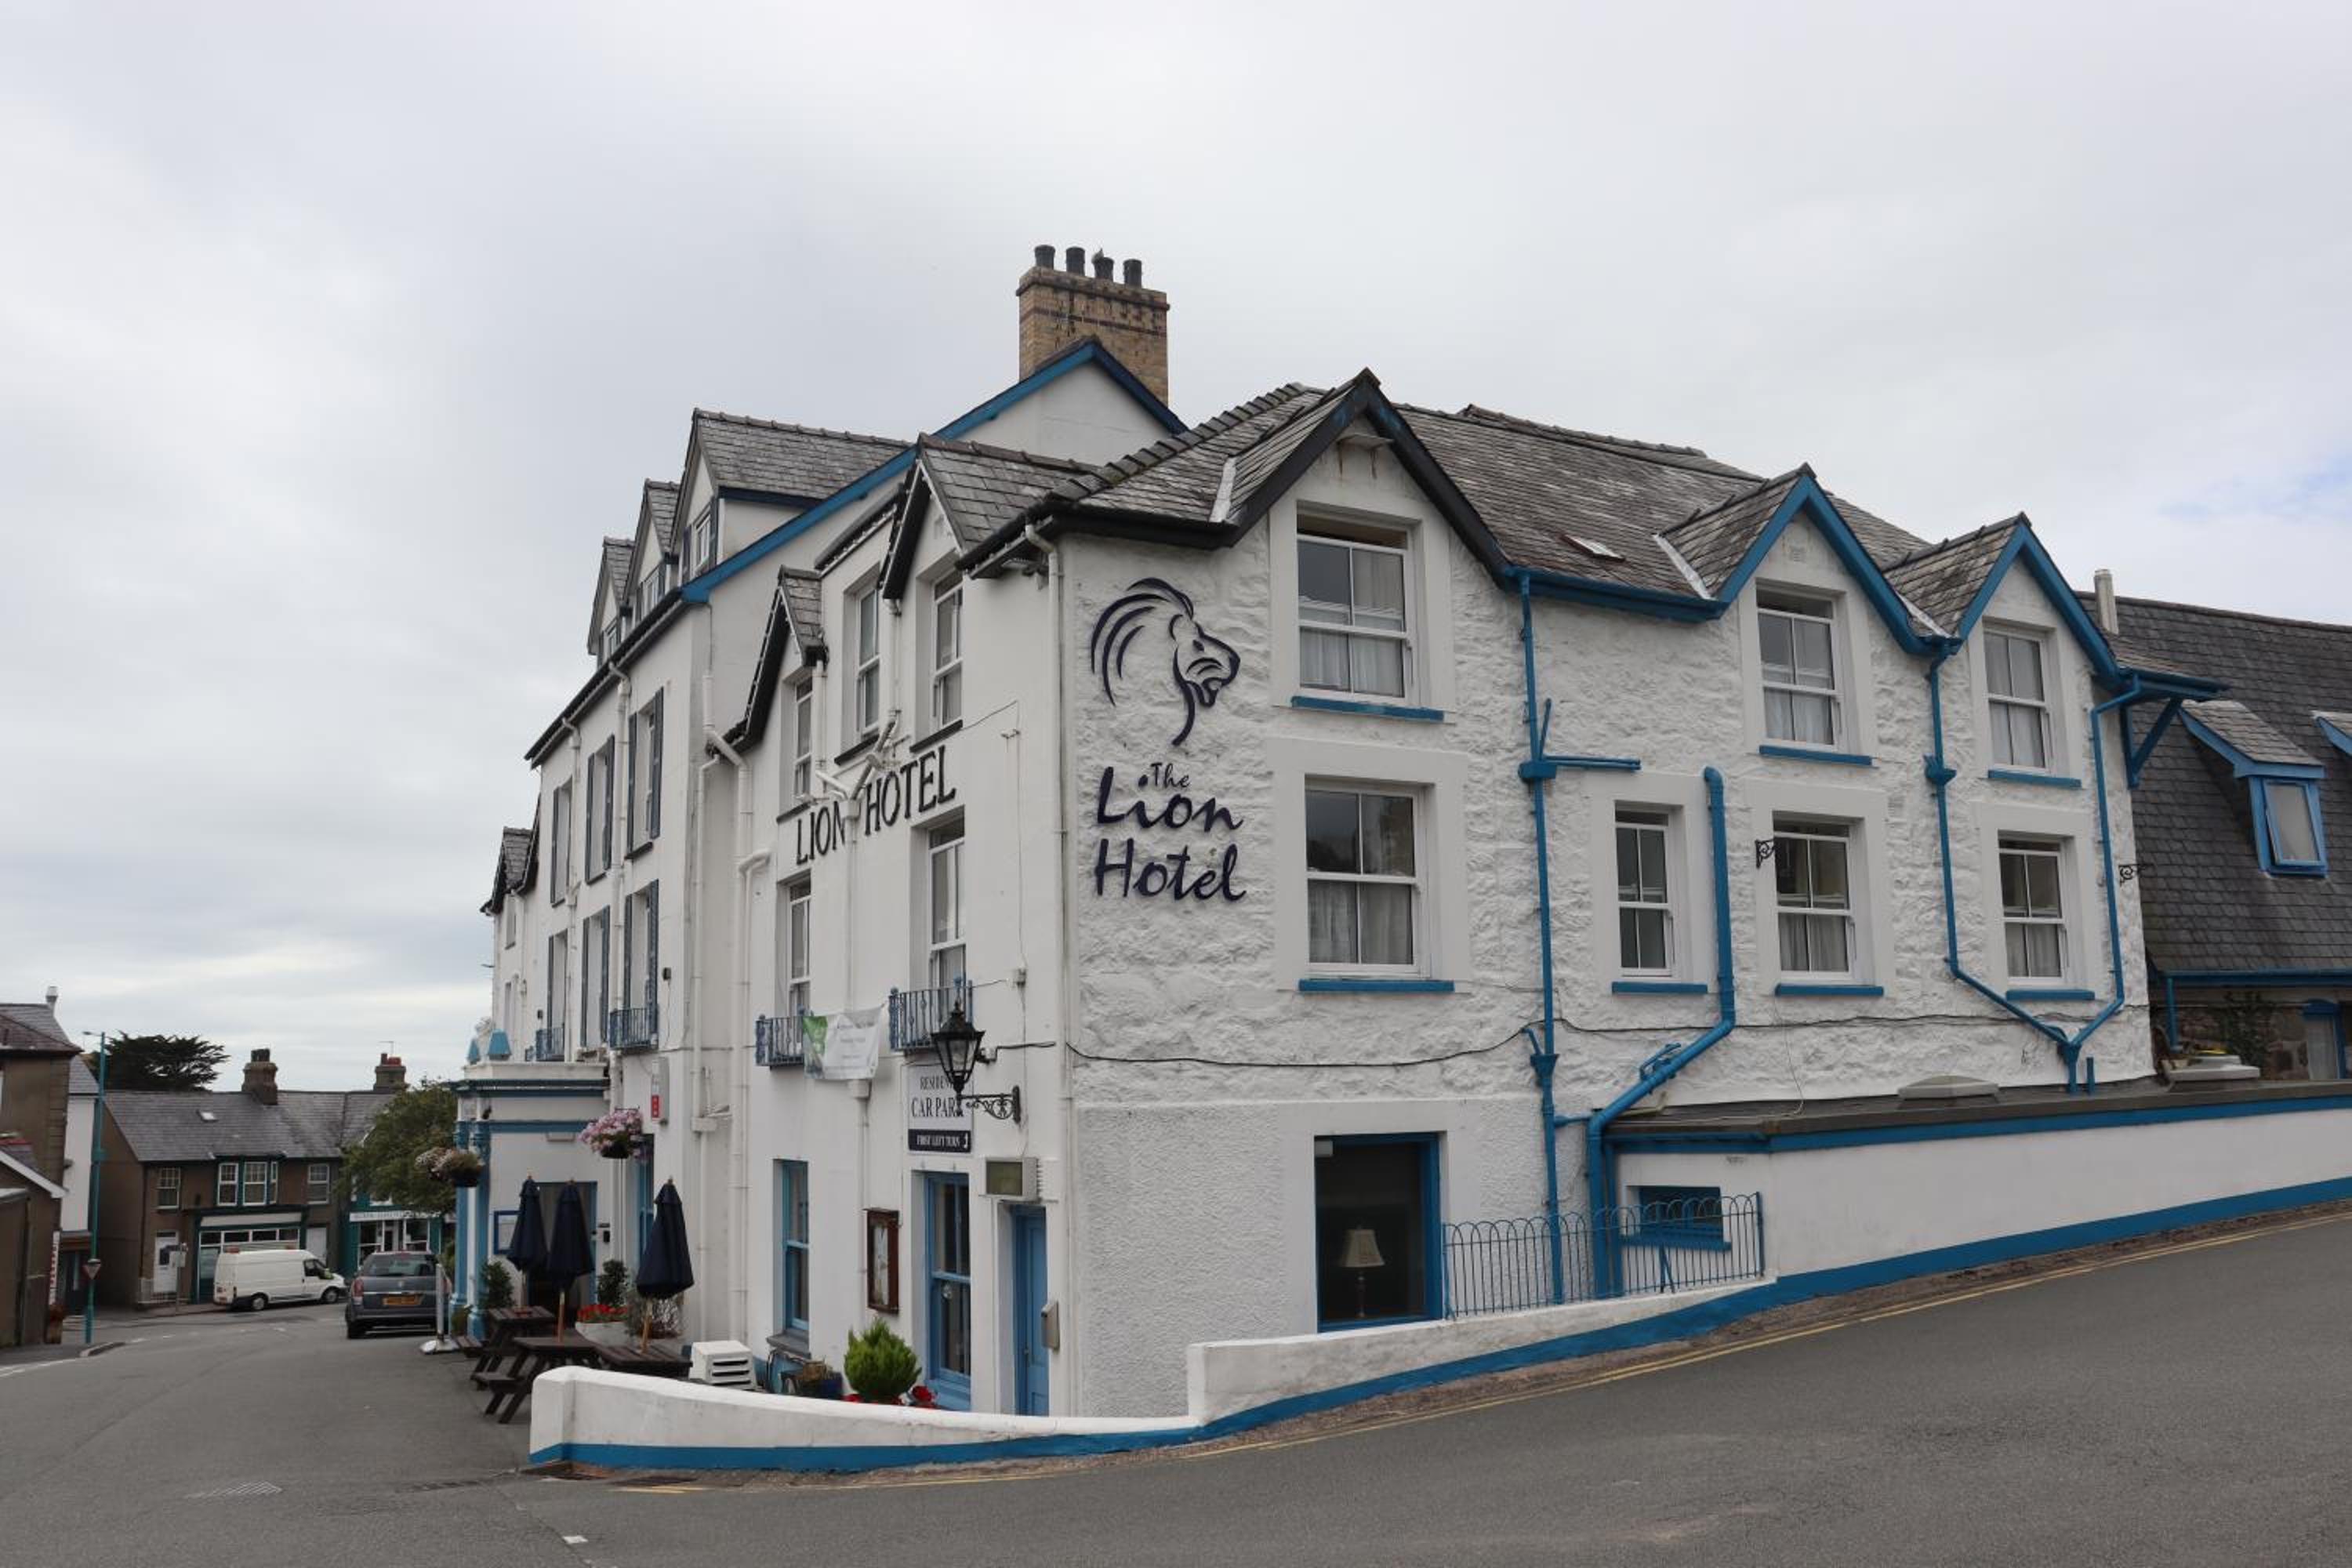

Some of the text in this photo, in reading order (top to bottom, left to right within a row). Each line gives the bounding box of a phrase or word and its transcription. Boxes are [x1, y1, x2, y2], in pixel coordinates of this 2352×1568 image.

[796, 745, 956, 866] LION HOTEL
[1098, 766, 1244, 833] Lion
[1150, 762, 1191, 788] The
[1094, 837, 1247, 902] Hotel
[911, 1097, 935, 1117] CAR
